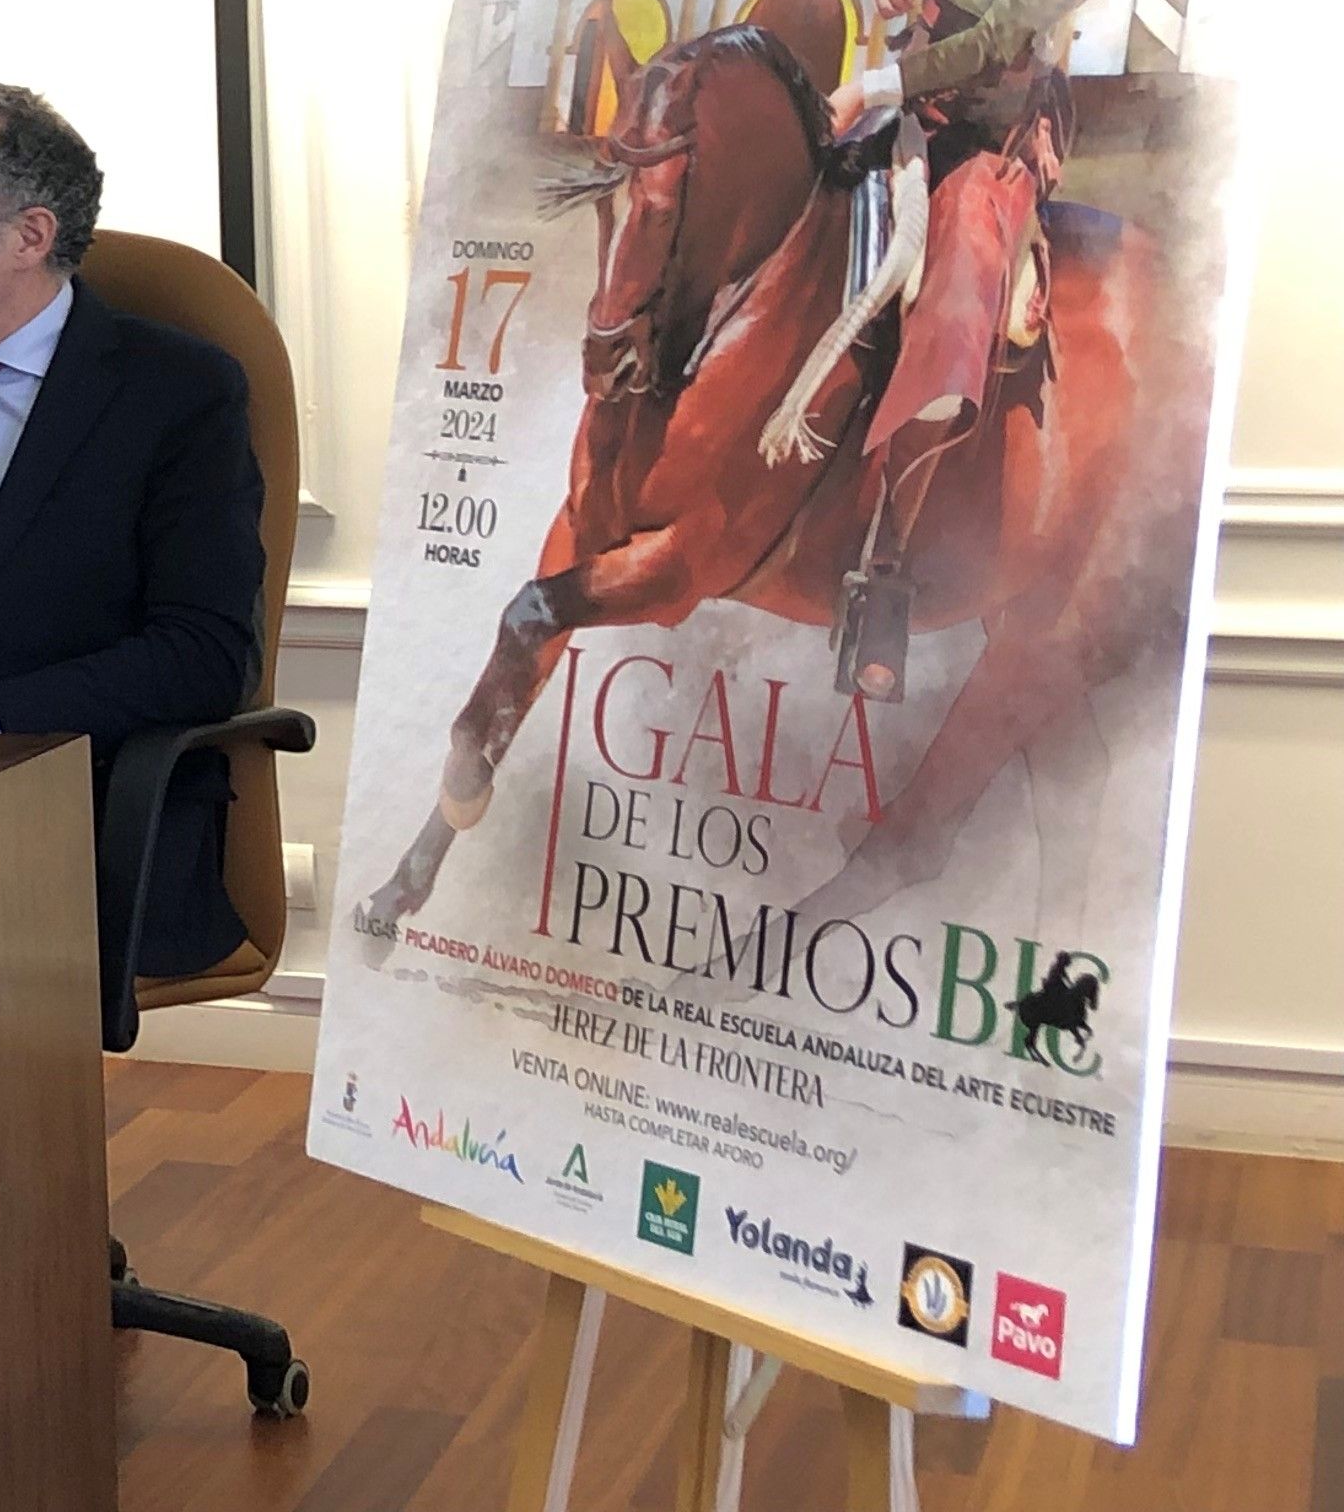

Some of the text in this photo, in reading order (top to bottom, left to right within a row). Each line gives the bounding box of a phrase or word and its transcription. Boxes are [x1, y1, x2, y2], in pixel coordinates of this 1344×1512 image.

[453, 240, 534, 260] DOMINGO
[436, 266, 531, 375] 17
[440, 408, 496, 442] 2024
[443, 380, 503, 402] MARZO
[417, 492, 497, 539] 12.00
[424, 543, 481, 568] HORAS
[593, 655, 884, 825] GALA
[582, 781, 772, 876] DE LOS
[567, 860, 923, 1028] PREMIOS
[405, 928, 479, 963] PICADERO
[481, 945, 541, 981] ÁLVARO
[622, 986, 645, 1010] DE
[648, 992, 668, 1016] LA
[673, 1002, 716, 1029] REAL
[720, 1013, 797, 1050] ESCUELA
[801, 1033, 906, 1080] ANDALUZA
[911, 1062, 948, 1093] DEL
[952, 1075, 1004, 1106] ARTE
[1010, 1089, 1116, 1138] ECUESTRE
[550, 1003, 825, 1108] JEREZ DE LA FRONTERA
[392, 1093, 525, 1185] Andalucía
[512, 1048, 858, 1176] VENTA ONLINE: www.realescuela.org/
[584, 1101, 763, 1170] HASTA COMPLETAR AFORO
[725, 1205, 853, 1281] Yolanda
[998, 1316, 1057, 1360] Pavo
